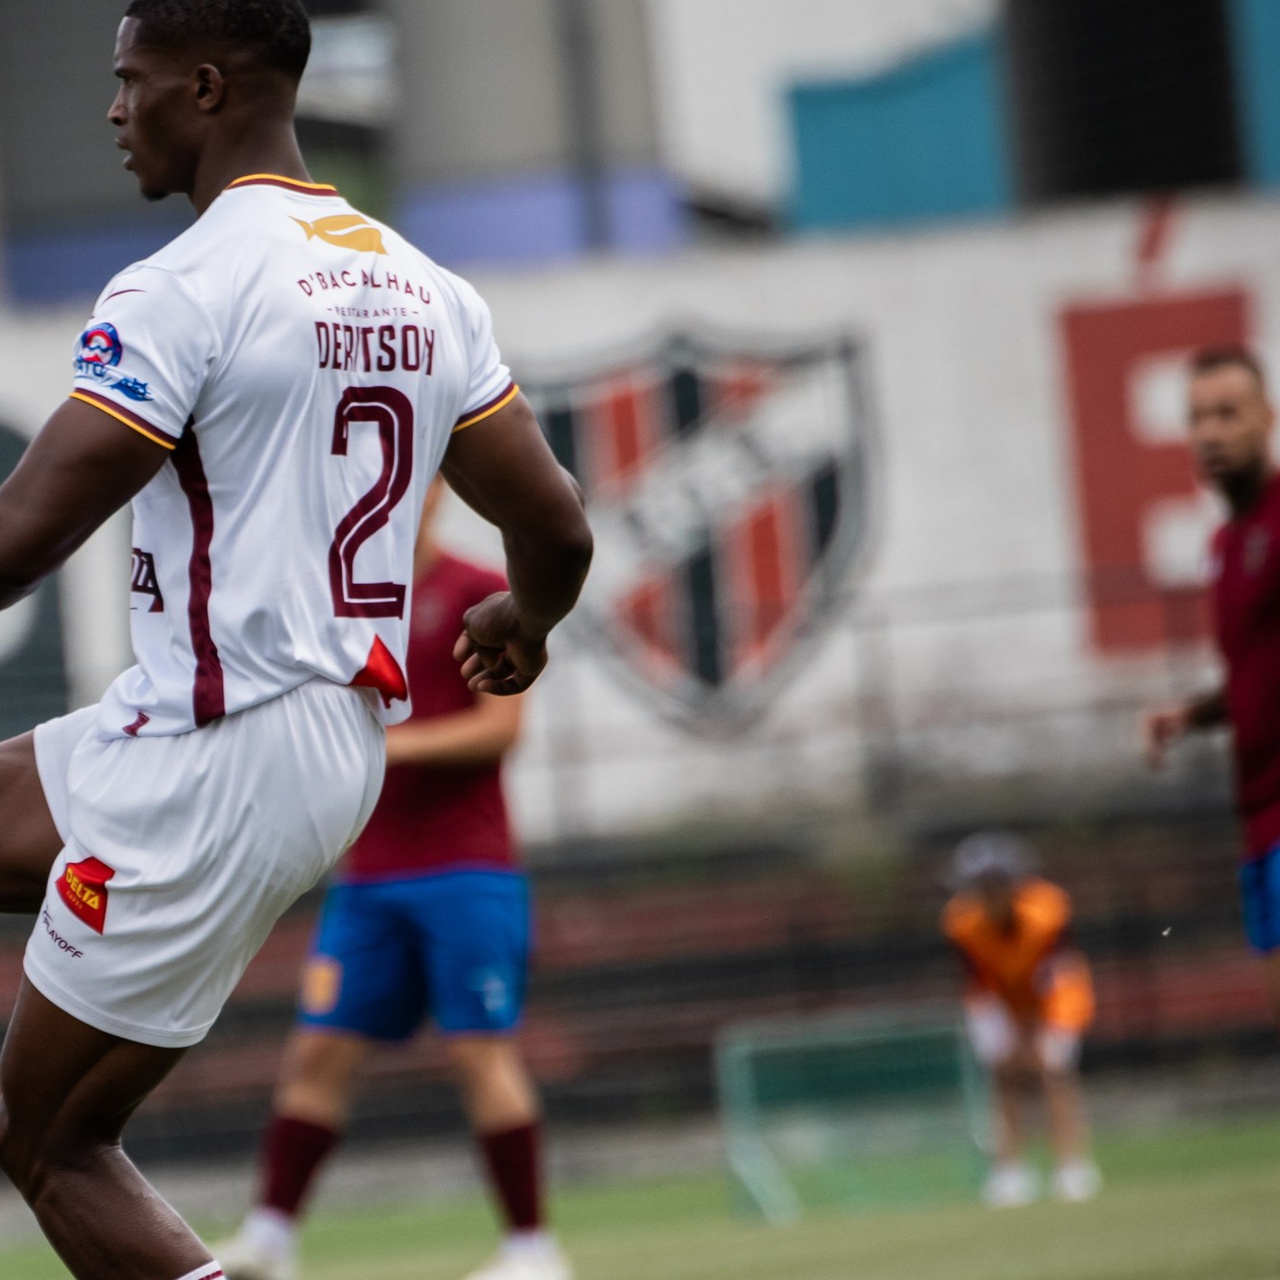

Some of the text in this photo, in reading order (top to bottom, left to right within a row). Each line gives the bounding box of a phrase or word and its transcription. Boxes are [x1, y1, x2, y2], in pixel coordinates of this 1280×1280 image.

[297, 269, 431, 305] D'BACALHAU
[328, 386, 414, 620] 2
[65, 867, 100, 910] DELTA
[42, 916, 84, 959] PLAYOFF
